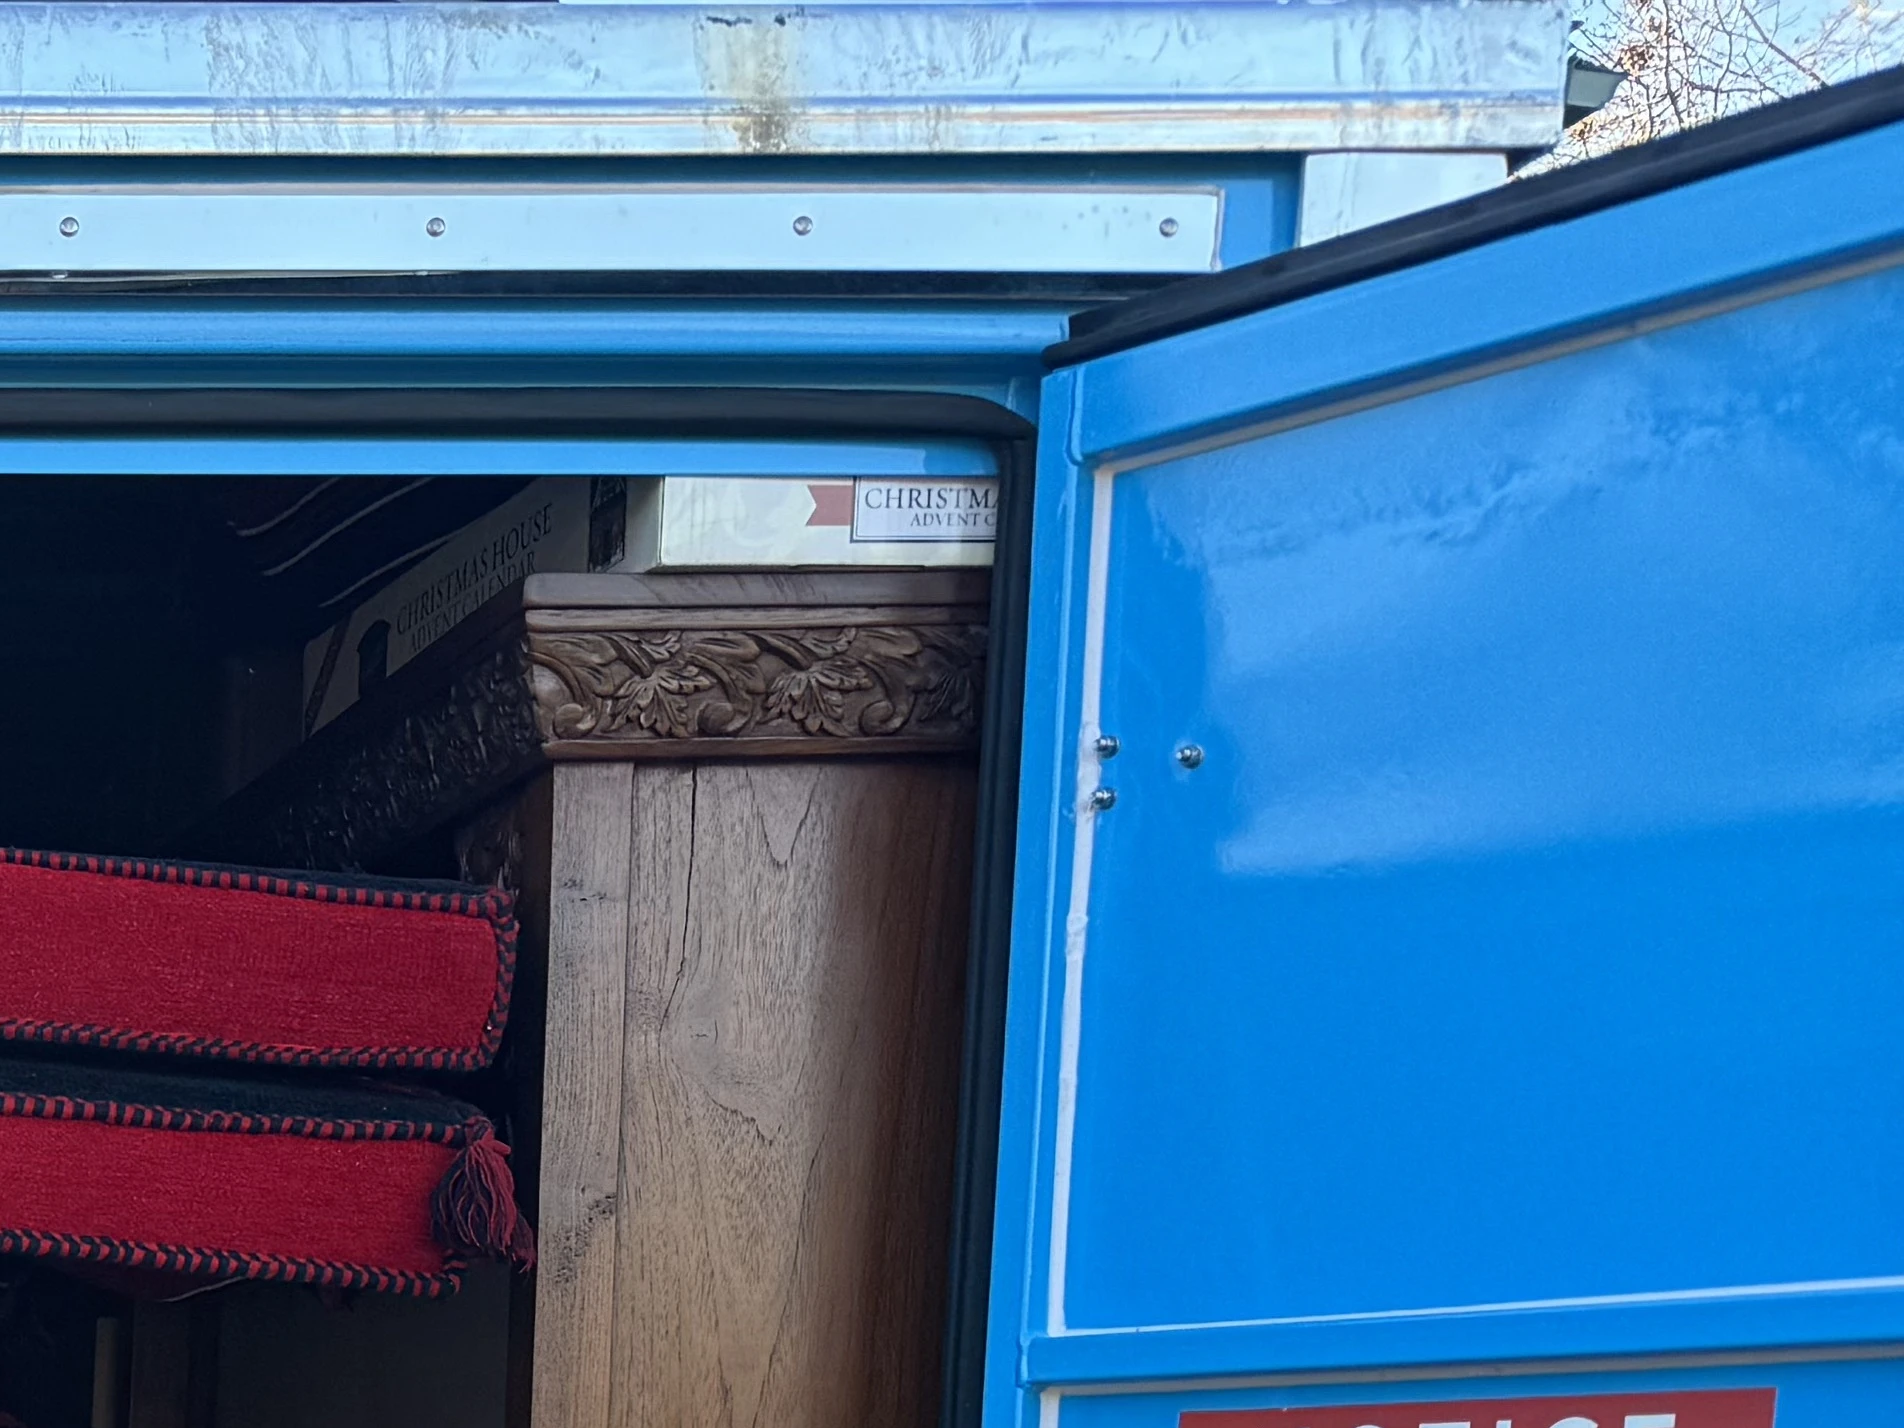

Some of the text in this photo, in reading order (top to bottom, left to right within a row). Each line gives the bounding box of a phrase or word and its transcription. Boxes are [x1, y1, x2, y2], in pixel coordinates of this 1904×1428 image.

[910, 512, 980, 527] ADVENT
[397, 502, 553, 635] CHRISTMAS HOUSE
